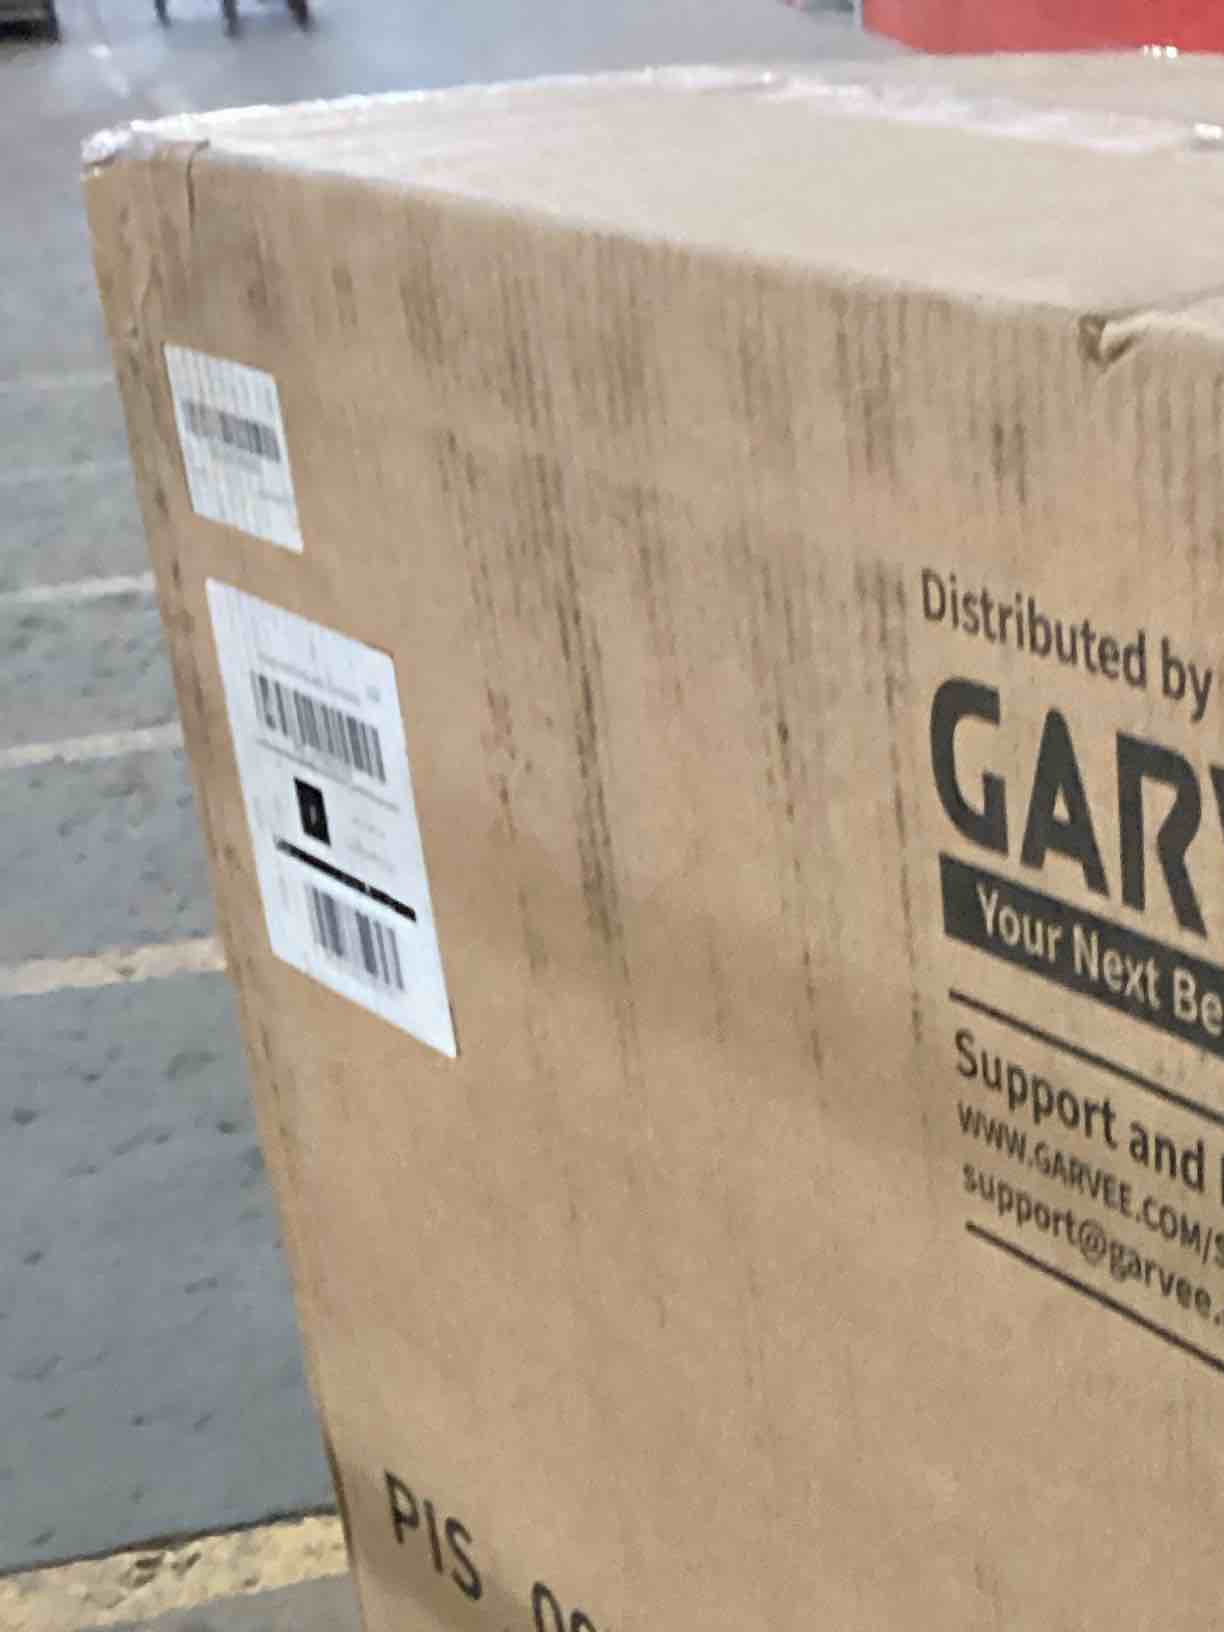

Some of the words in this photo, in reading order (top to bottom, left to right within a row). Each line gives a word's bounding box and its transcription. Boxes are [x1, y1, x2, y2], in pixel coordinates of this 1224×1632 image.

[921, 567, 1147, 690] Distributed
[1161, 637, 1213, 721] by
[976, 881, 1065, 963] Your
[1072, 925, 1160, 1009] Next
[954, 1028, 1117, 1150] Support
[1129, 1119, 1205, 1194] and
[384, 1468, 482, 1600] PIS
